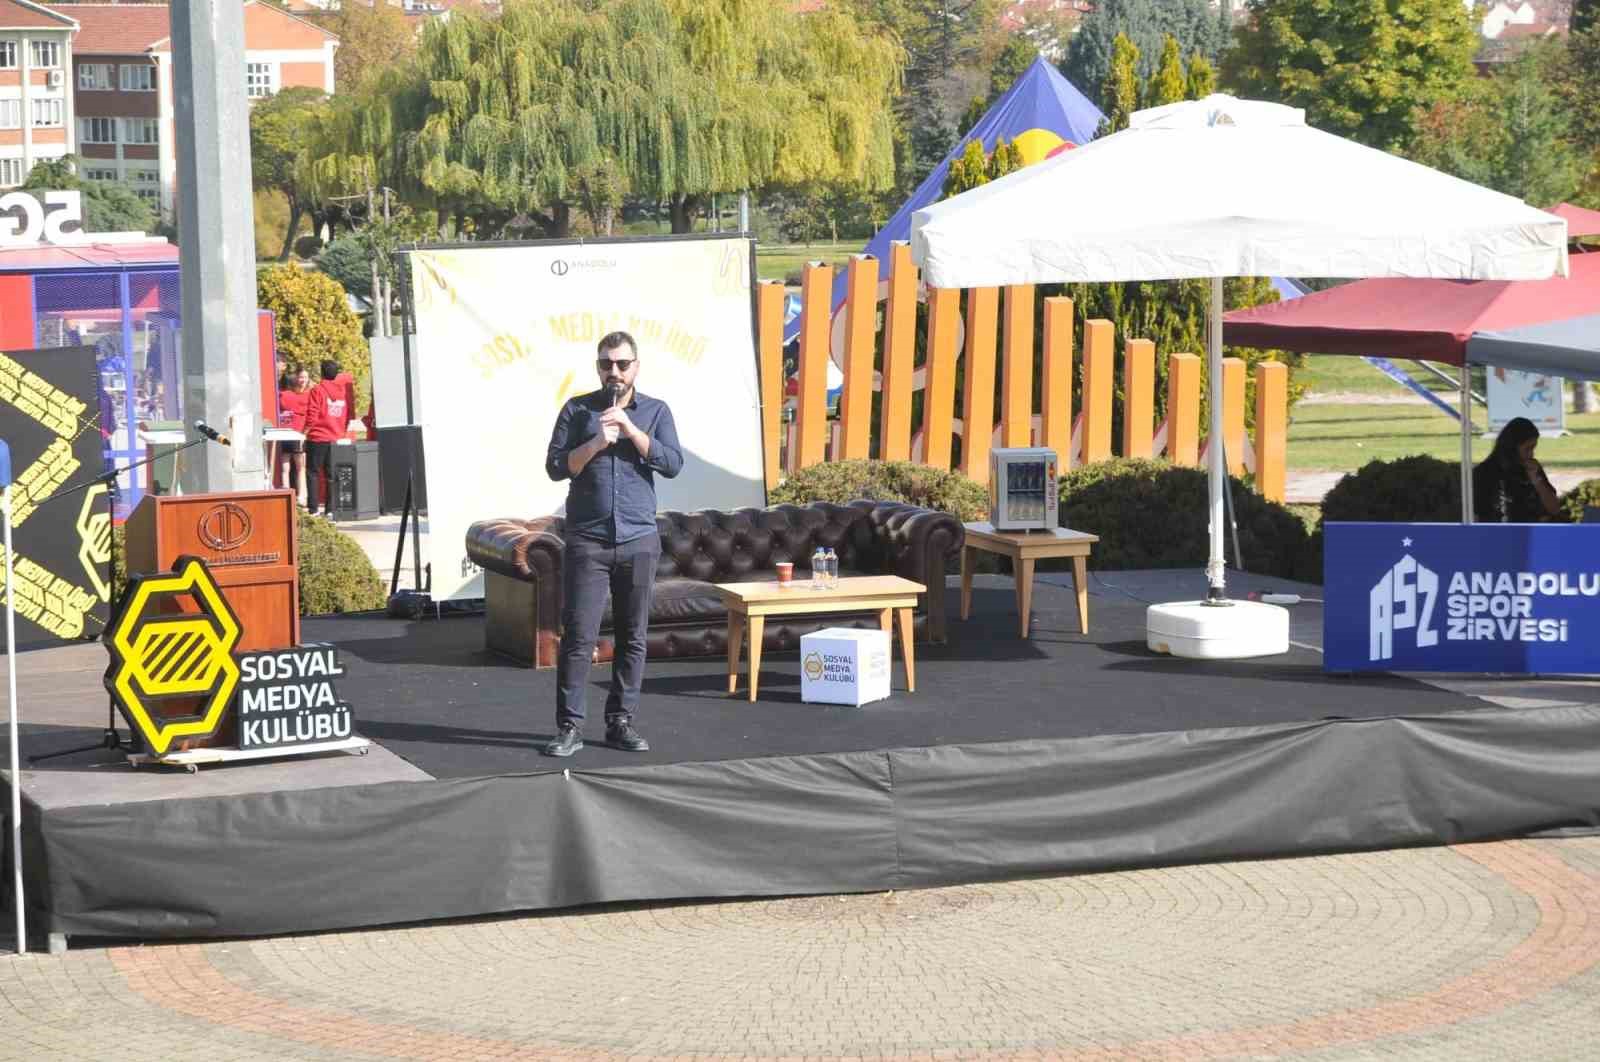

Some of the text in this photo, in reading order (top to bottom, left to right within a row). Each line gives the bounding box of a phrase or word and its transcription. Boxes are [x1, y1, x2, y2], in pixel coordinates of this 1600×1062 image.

[1447, 572, 1600, 596] ANADOLU
[1447, 595, 1533, 618] SPOR
[241, 653, 342, 683] SOSYAL
[823, 654, 854, 664] SOSYAL
[823, 663, 850, 673] MEDYA
[243, 682, 336, 714] MEDYA
[243, 707, 351, 745] KULÜBÜ
